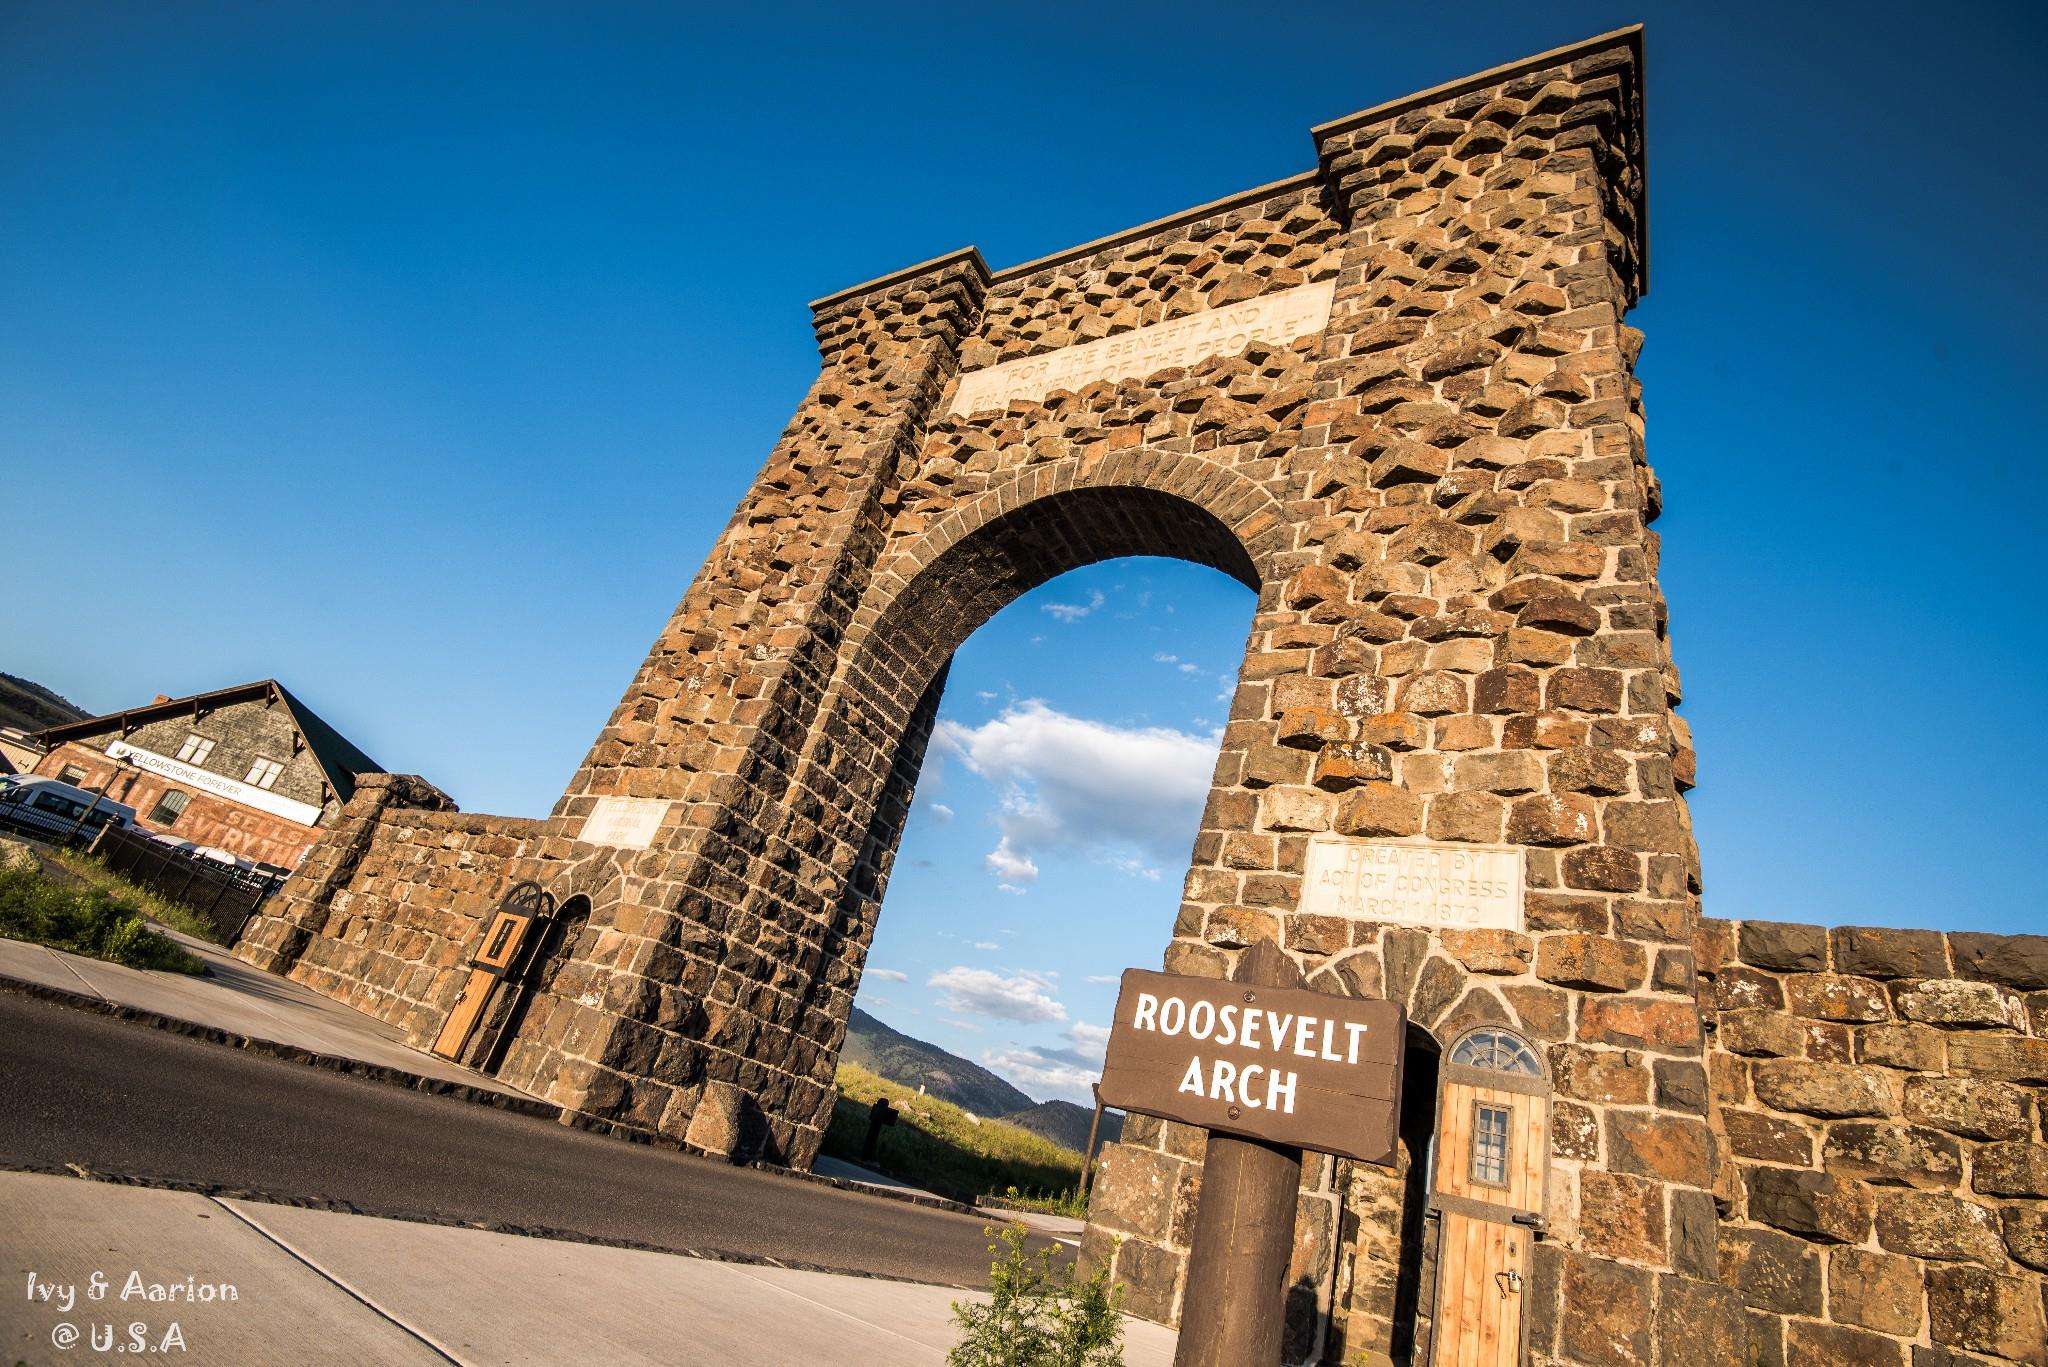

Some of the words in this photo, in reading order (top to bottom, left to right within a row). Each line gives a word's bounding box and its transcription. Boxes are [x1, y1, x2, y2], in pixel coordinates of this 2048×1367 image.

[1059, 348, 1096, 371] THE
[1104, 322, 1202, 360] BENEFIT
[1206, 307, 1262, 334] AND
[1100, 359, 1133, 381] OF
[1142, 347, 1187, 371] THE
[129, 750, 197, 781] YELLOWSTONE
[197, 774, 242, 796] FOREVER
[1350, 847, 1441, 869] CREATED
[1453, 852, 1481, 873] BY
[1319, 868, 1354, 888] ACT
[1360, 872, 1388, 889] OF
[1396, 874, 1509, 900] CONGRESS
[1337, 895, 1408, 918] MARCH
[1133, 992, 1368, 1065] ROOSEVELT
[1178, 1055, 1298, 1115] ARCH
